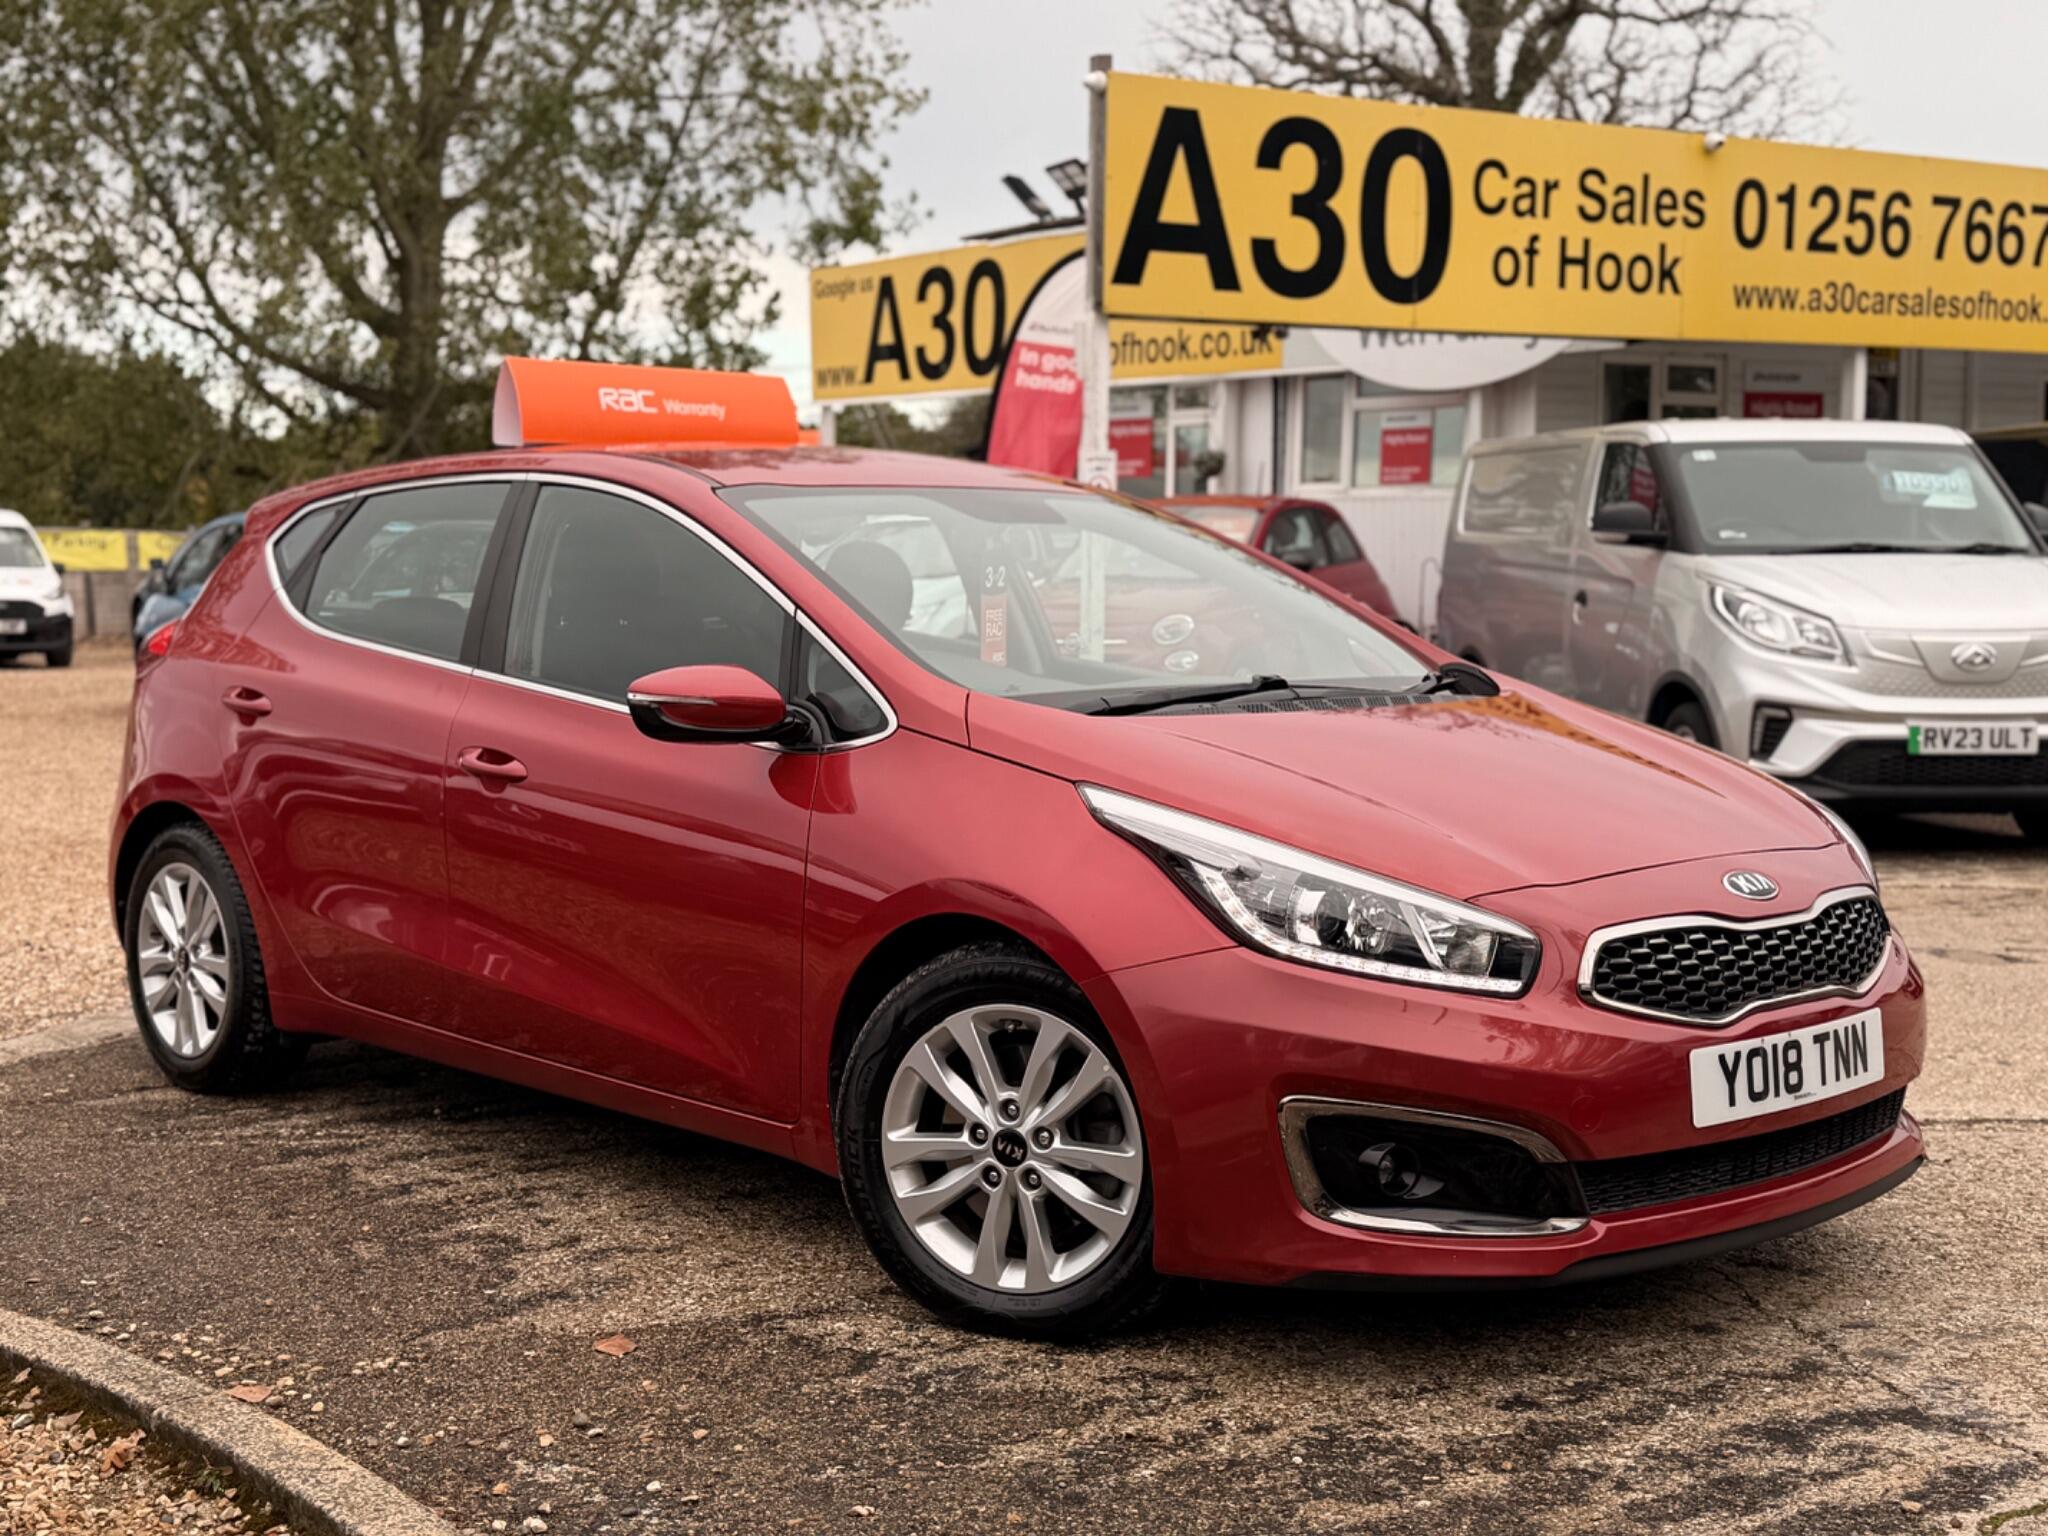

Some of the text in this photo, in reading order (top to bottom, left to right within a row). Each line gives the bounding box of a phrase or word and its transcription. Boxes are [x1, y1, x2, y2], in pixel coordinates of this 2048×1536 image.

[1112, 106, 1452, 304] A30
[1473, 159, 1706, 229] Car Sales
[1734, 178, 2048, 268] 01256 7667
[1493, 234, 1681, 295] of Hook
[863, 259, 1006, 384] A30
[662, 398, 726, 421] Warranty
[1015, 367, 1077, 395] hands
[1924, 727, 2033, 749] RV23 ULT
[1733, 873, 1776, 895] KIA
[1718, 1020, 1868, 1107] YO18 TNN
